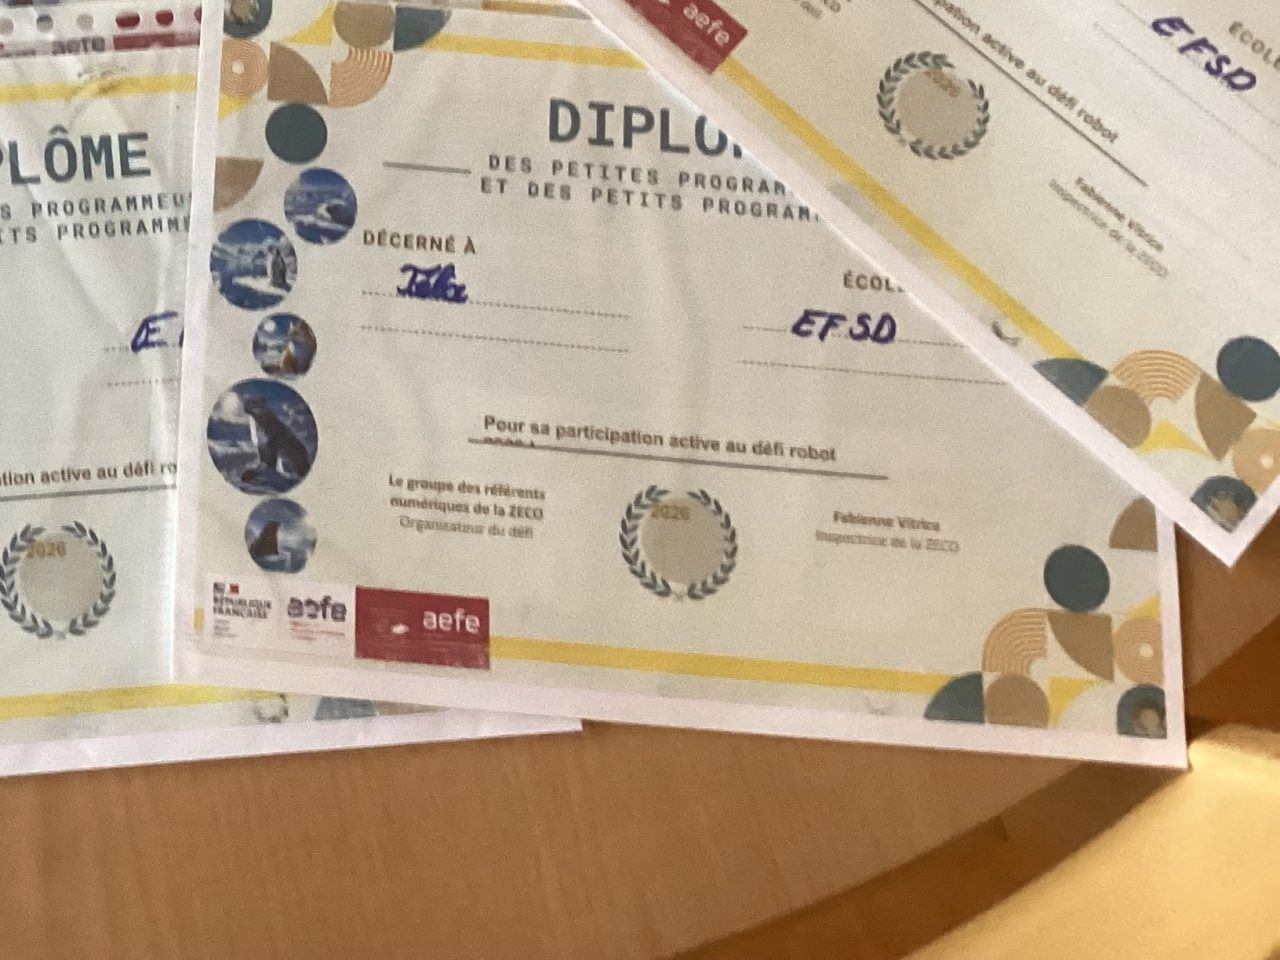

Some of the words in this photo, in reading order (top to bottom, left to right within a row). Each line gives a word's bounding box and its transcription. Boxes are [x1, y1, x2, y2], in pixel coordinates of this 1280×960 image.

[683, 3, 730, 47] aefe
[982, 33, 1025, 70] active
[1026, 68, 1048, 87] au
[1047, 83, 1079, 111] défi
[1077, 108, 1119, 143] robot
[489, 154, 533, 174] DES
[551, 159, 659, 185] PETITES
[31, 192, 192, 219] PROGRAMMEU
[480, 177, 508, 195] ET
[527, 181, 572, 201] DES
[591, 188, 684, 211] PETITS
[703, 196, 819, 222] PROGRAM
[363, 228, 456, 254] DÉCERNÉ
[791, 309, 897, 344] EFSD
[484, 415, 525, 433] Pour
[530, 423, 550, 435] sa
[556, 423, 663, 446] participation
[668, 434, 720, 453] active
[725, 439, 746, 454] au
[752, 441, 784, 457] défi
[789, 446, 836, 462] robot
[40, 466, 92, 485] active
[97, 465, 118, 479] au
[123, 458, 154, 478] défi
[423, 608, 481, 635] aefe
